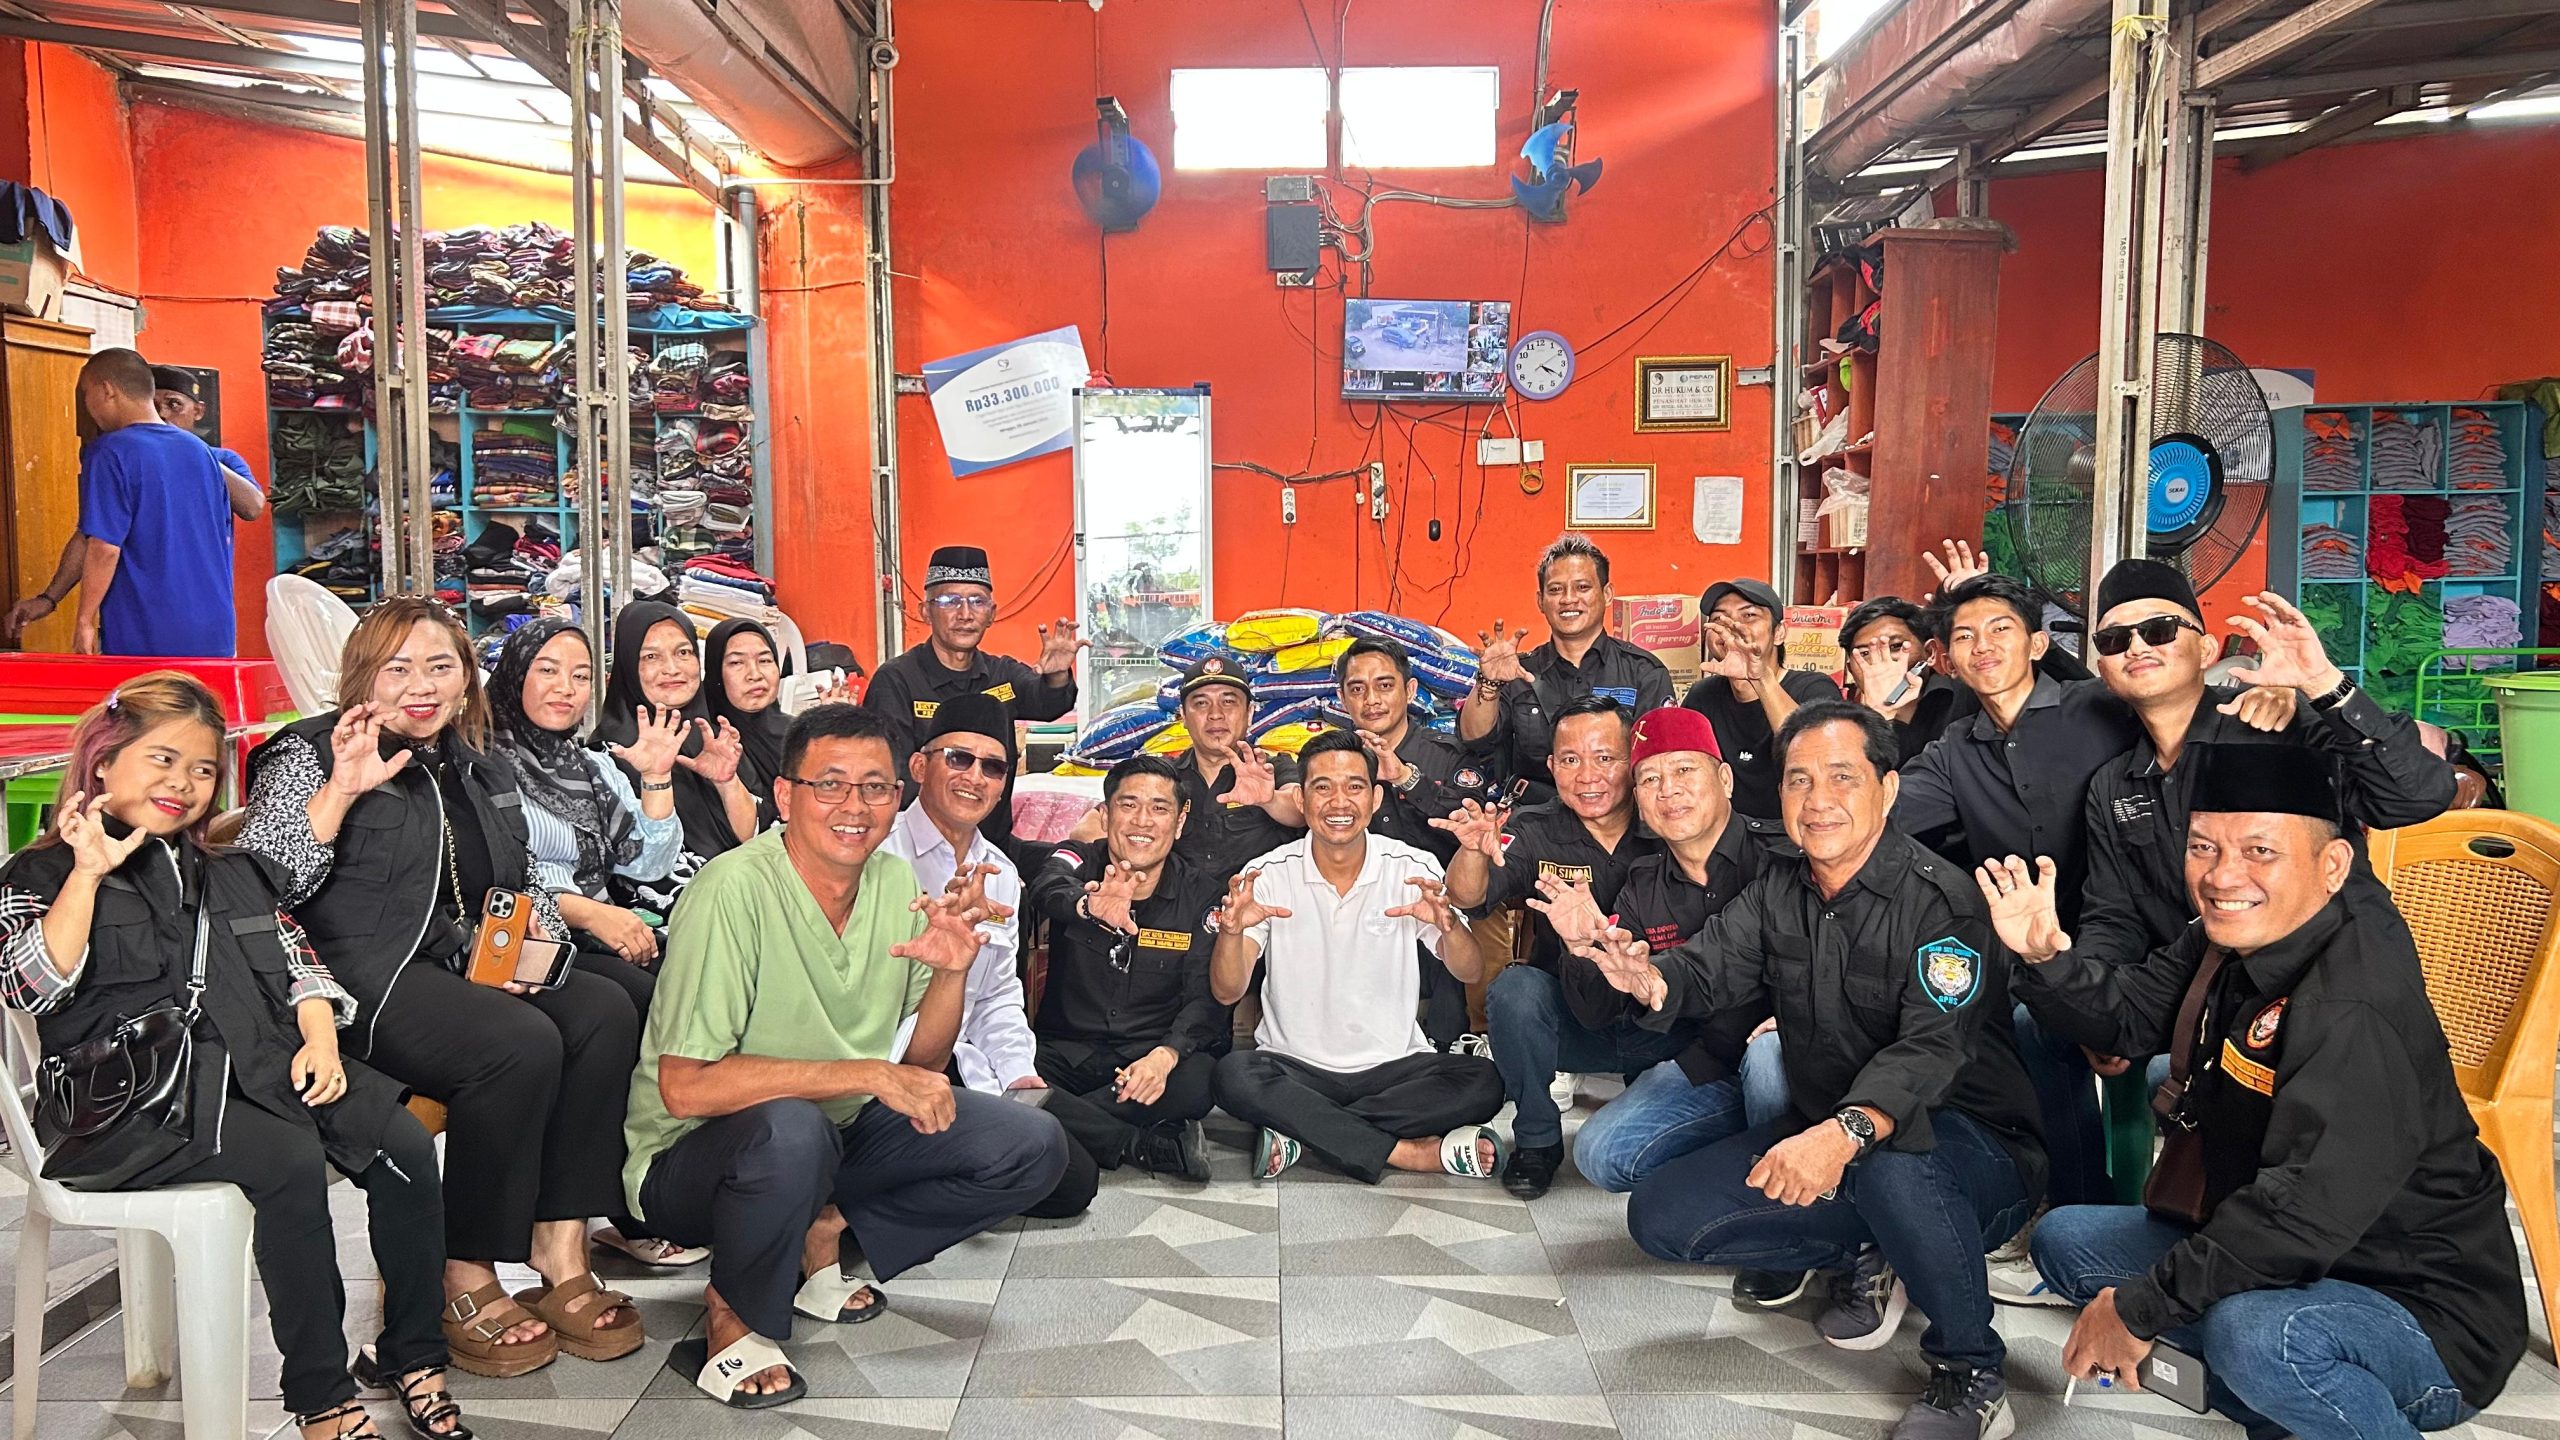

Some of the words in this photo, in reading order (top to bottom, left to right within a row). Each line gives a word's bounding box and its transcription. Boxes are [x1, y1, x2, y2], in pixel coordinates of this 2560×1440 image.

[965, 376, 1060, 412] Rp33.300.000
[1657, 635, 1691, 644] goreng
[1801, 633, 1822, 644] Mi
[1785, 642, 1838, 656] Goreng
[1802, 662, 1816, 672] 40
[1465, 1145, 1477, 1175] LACOSTE
